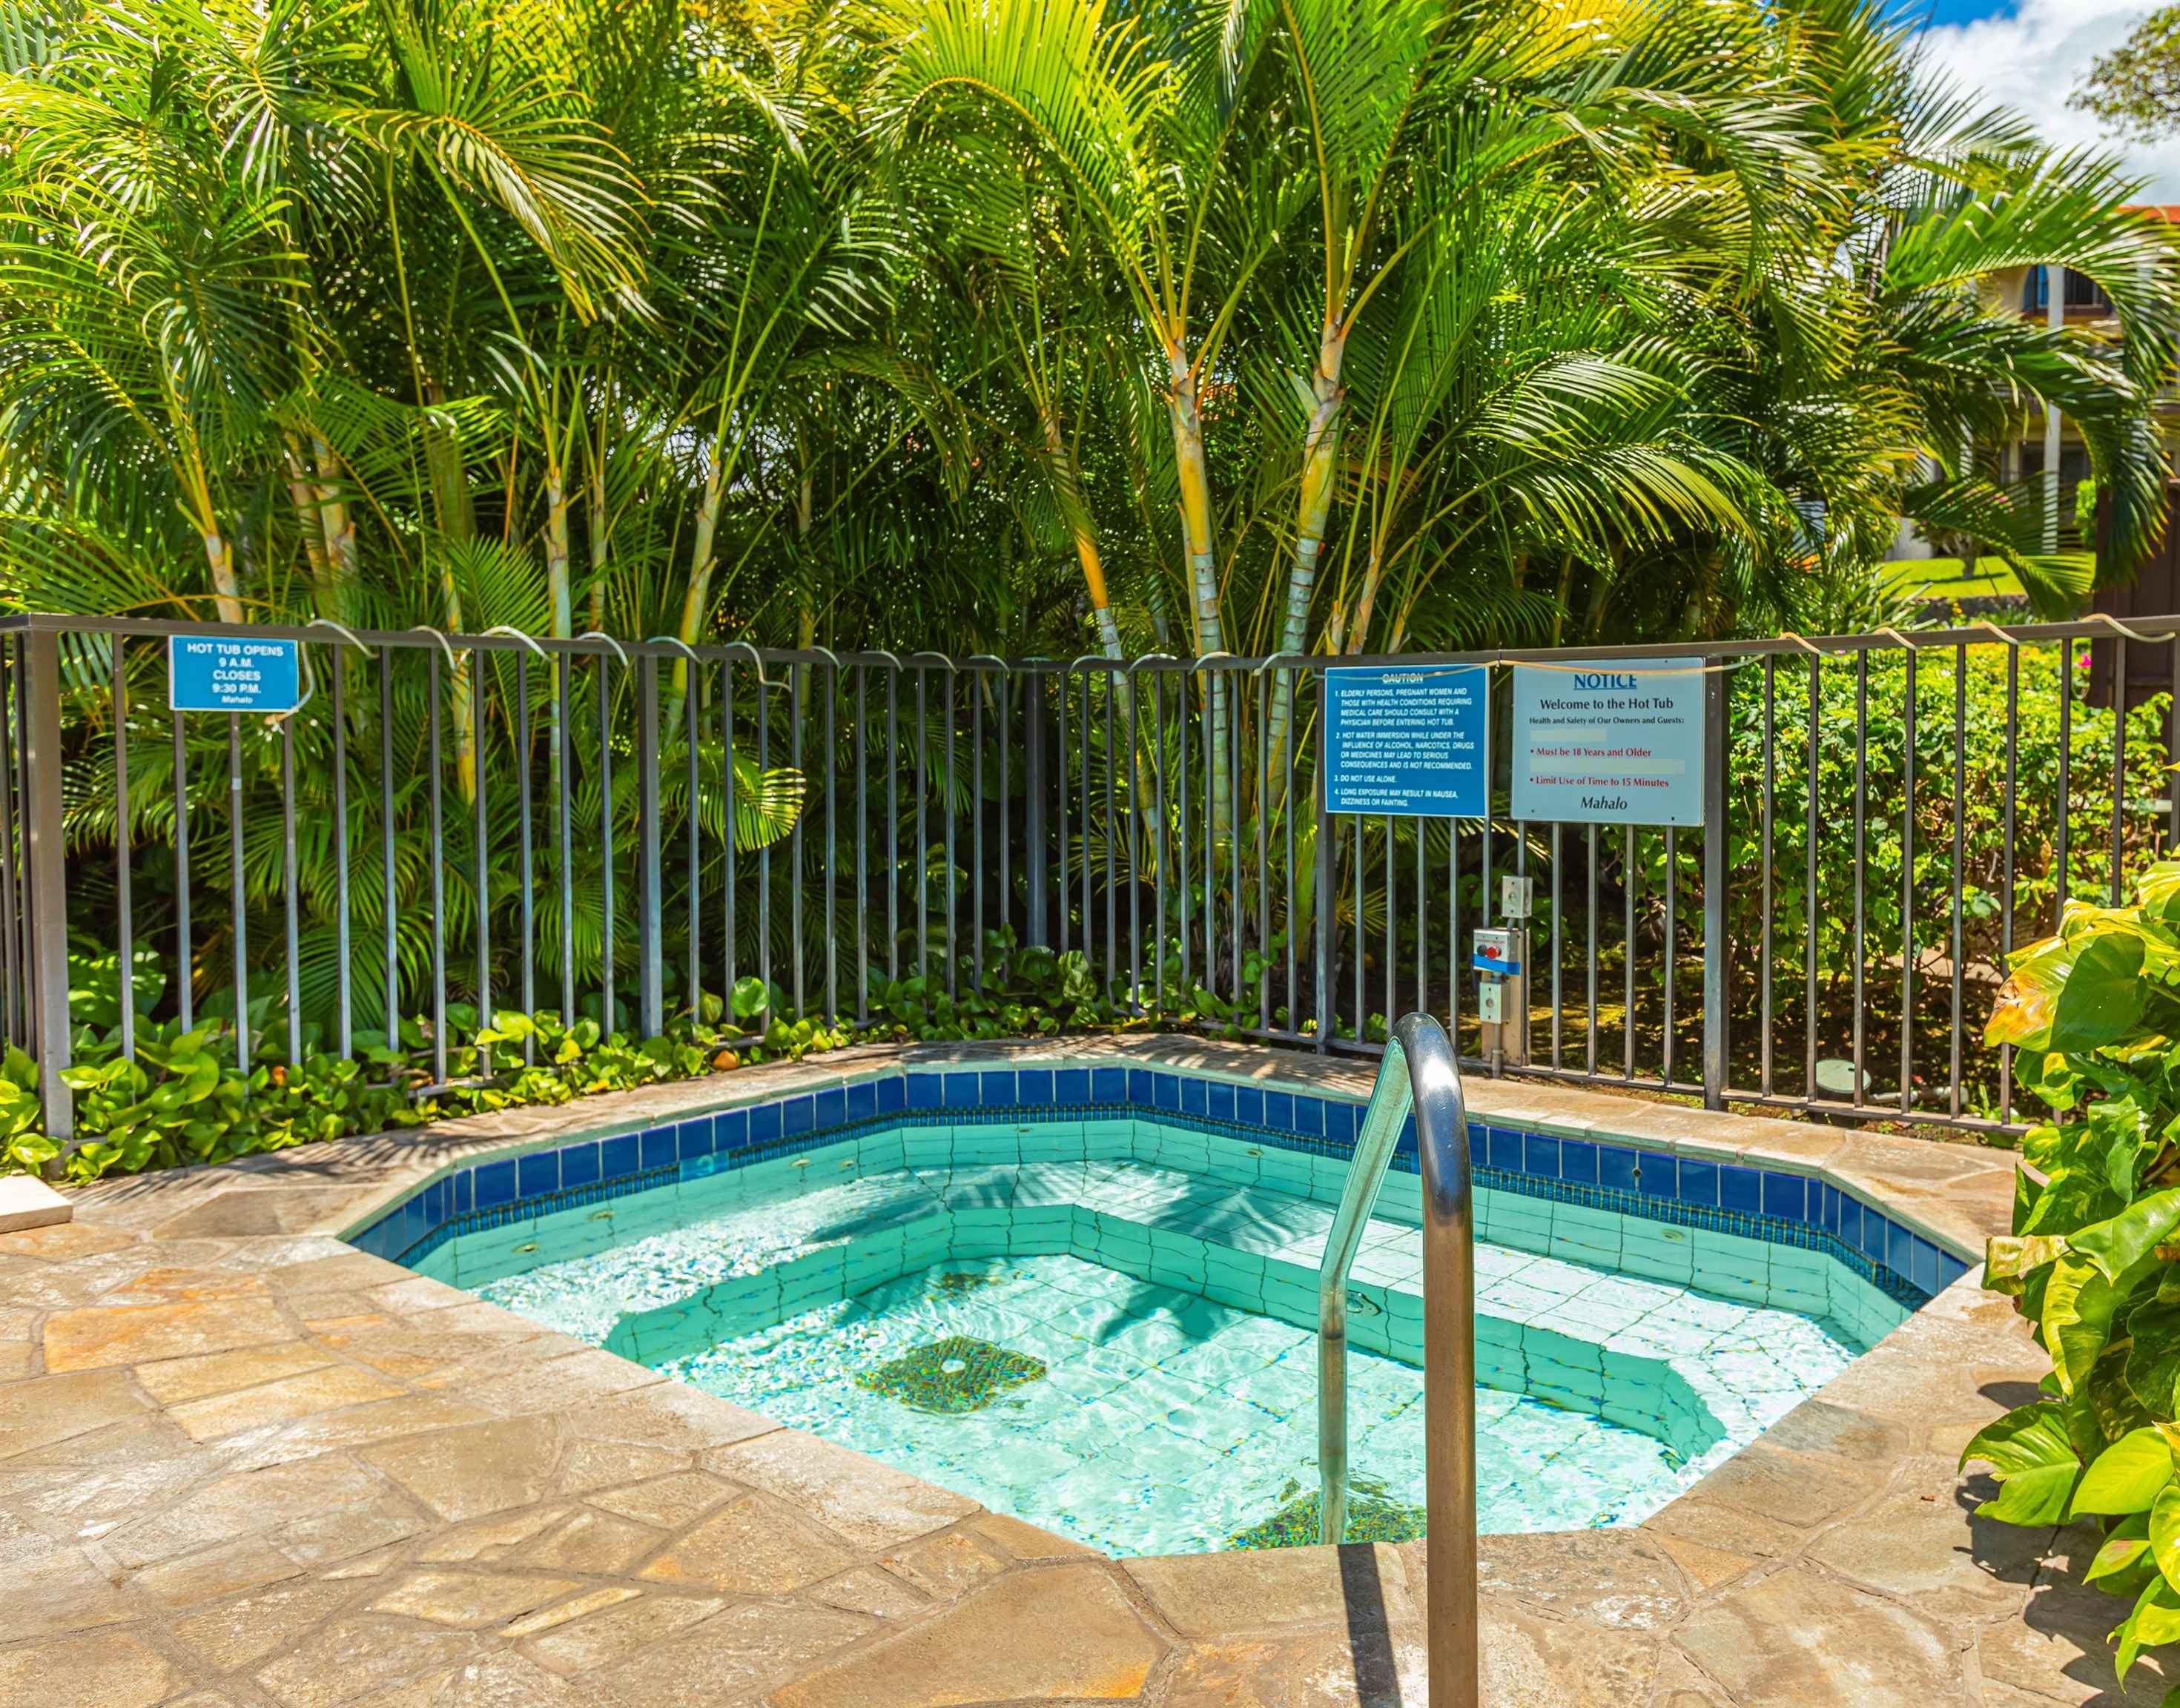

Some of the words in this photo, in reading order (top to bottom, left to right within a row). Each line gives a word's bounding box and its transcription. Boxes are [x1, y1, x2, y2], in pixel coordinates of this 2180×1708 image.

[187, 643, 213, 654] HOT
[216, 644, 241, 655] TUB
[243, 646, 284, 657] OPENS
[219, 658, 226, 666] 9
[229, 658, 254, 667] A.M.
[213, 670, 261, 681] CLOSES
[1381, 673, 1424, 683] CAUTION
[1573, 674, 1637, 689] NOTICE
[212, 683, 237, 693] 9:30
[240, 684, 261, 694] P.M.
[222, 695, 253, 704] Mahalo
[1541, 699, 1590, 709] Welcome
[1593, 700, 1603, 709] to
[1608, 699, 1625, 709] the
[1628, 698, 1649, 709] Hot
[1652, 698, 1673, 709] Tub
[1567, 717, 1586, 725] Safety
[1415, 741, 1451, 749] NARCOTICS,
[1536, 748, 1557, 756] Must
[1584, 748, 1605, 756] Years
[1607, 748, 1623, 757] and
[1625, 748, 1652, 757] Older
[1424, 761, 1472, 769] RECOMMENDED.
[1536, 776, 1556, 784] Limit
[1559, 776, 1574, 785] Use
[1577, 776, 1586, 785] of
[1588, 777, 1608, 786] Time
[1611, 778, 1618, 786] to
[1633, 778, 1669, 787] Minutes
[1358, 788, 1387, 796] EXPOSURE
[1371, 798, 1380, 806] OR
[1381, 798, 1409, 807] FAINTING.
[1580, 796, 1628, 810] Mahalo
